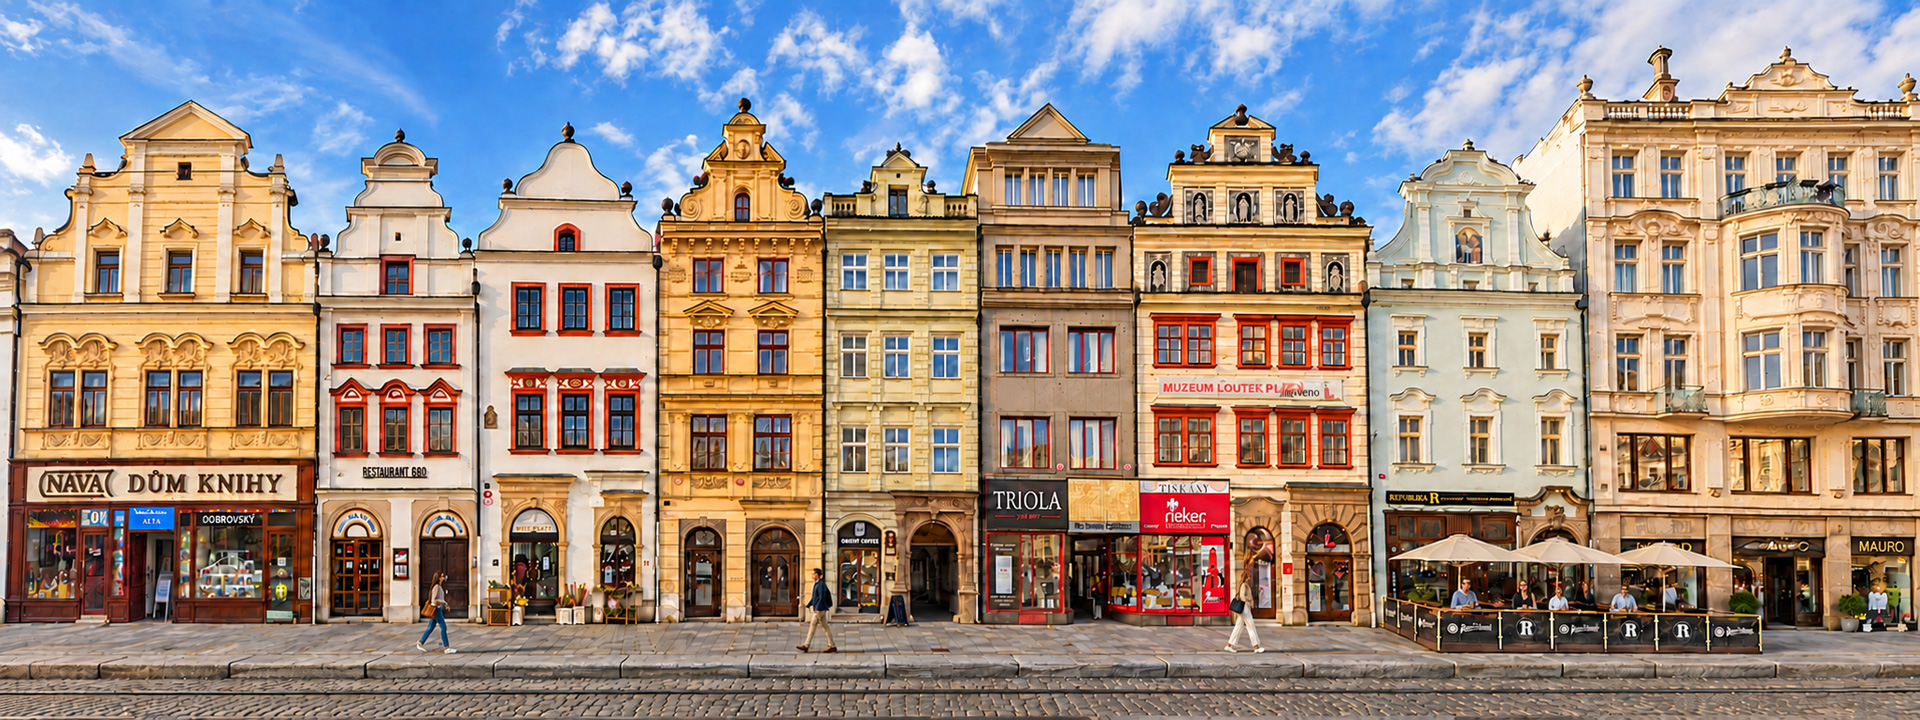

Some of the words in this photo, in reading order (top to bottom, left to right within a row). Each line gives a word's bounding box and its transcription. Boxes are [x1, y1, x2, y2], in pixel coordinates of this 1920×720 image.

[1163, 383, 1214, 393] MUZEUM
[1217, 383, 1264, 393] LOUTEK
[362, 466, 409, 478] RESTAURANT
[127, 470, 187, 493] DŮM
[197, 473, 282, 493] KNIHY
[993, 491, 1062, 510] TRIOLA
[1430, 492, 1440, 504] R
[1859, 540, 1905, 553] MAURO
[1520, 620, 1534, 635] R
[1624, 623, 1637, 637] R
[1676, 623, 1690, 638] R
